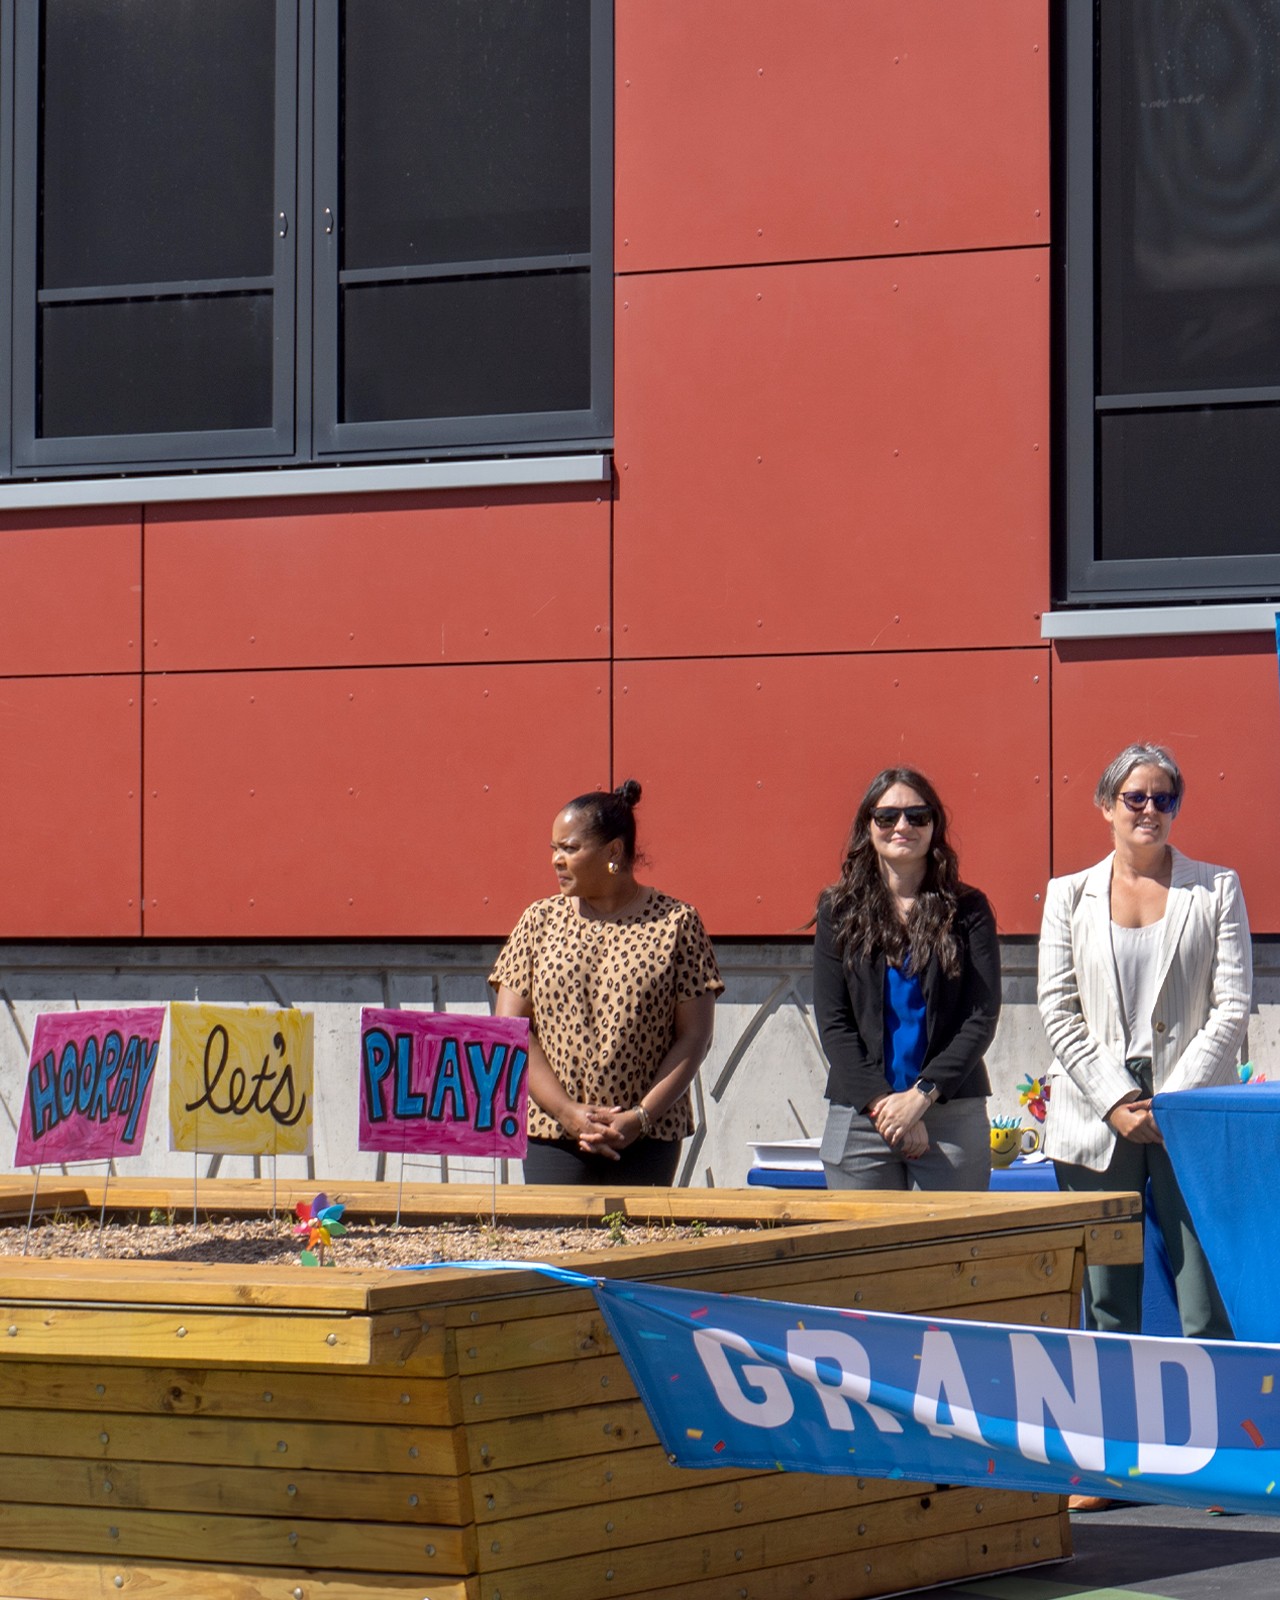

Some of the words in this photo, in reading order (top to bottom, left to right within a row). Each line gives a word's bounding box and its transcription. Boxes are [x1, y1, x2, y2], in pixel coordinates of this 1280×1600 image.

[29, 1029, 160, 1144] HOORAY
[185, 1024, 307, 1126] let's
[363, 1027, 528, 1137] PLAY!
[693, 1328, 1219, 1475] GRAND
